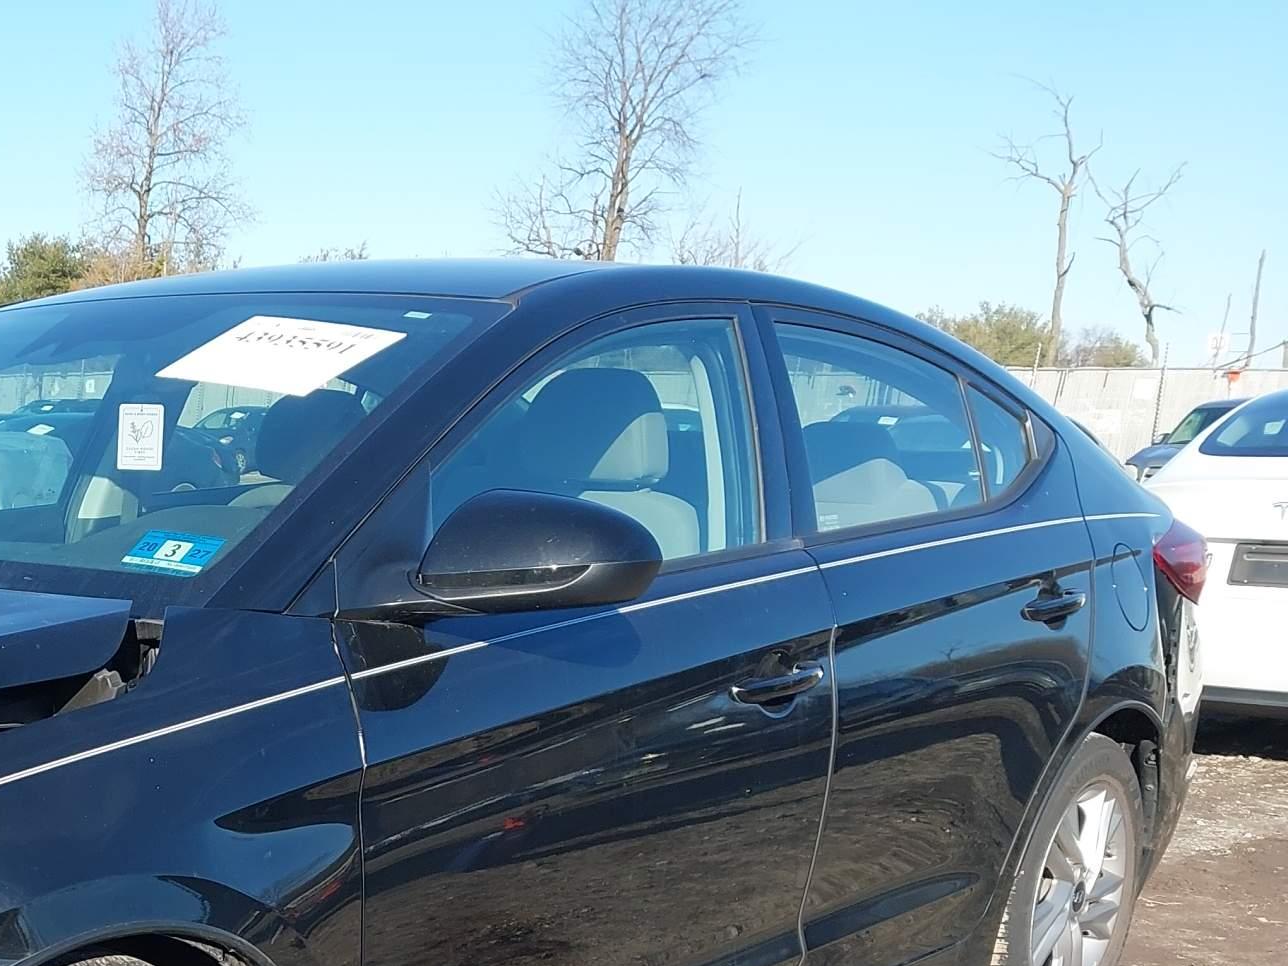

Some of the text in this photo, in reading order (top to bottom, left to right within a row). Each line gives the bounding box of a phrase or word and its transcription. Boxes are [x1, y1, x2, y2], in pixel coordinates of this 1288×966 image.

[138, 541, 212, 559] 20 3 27
